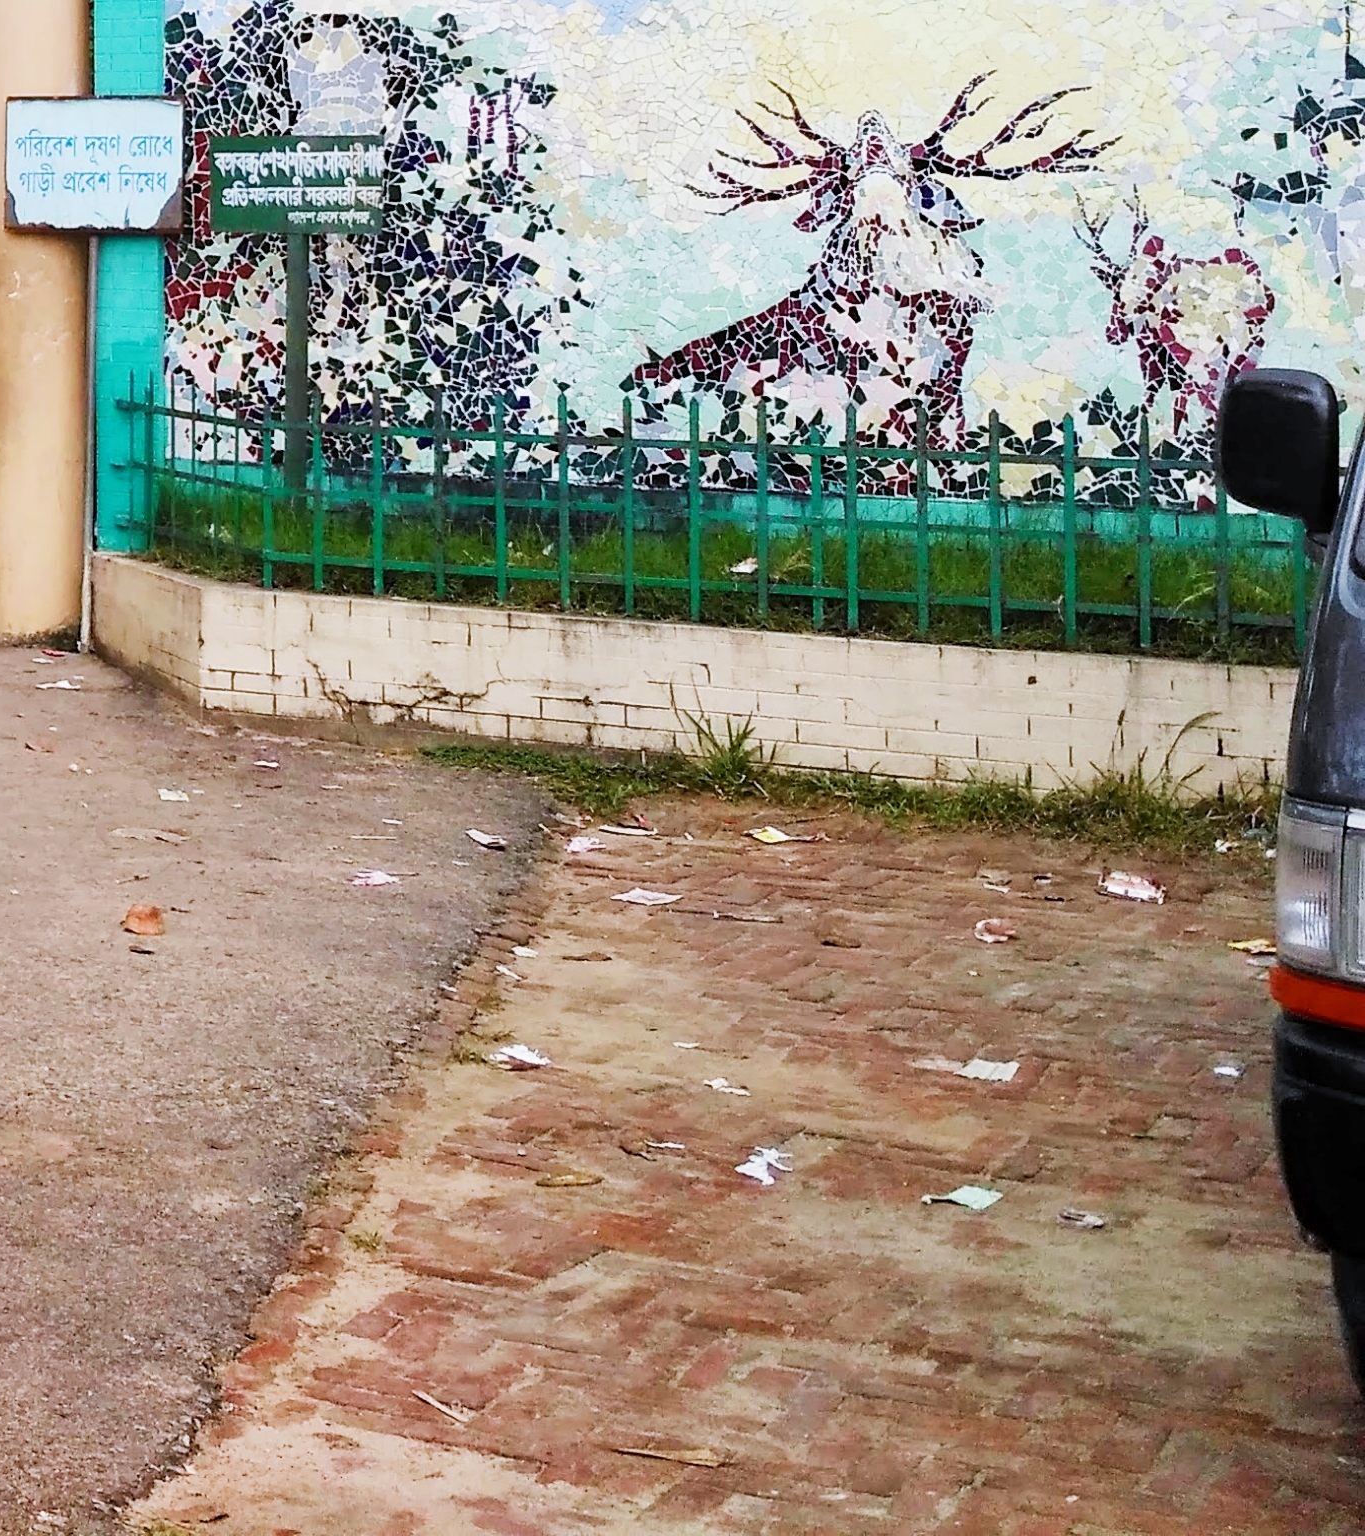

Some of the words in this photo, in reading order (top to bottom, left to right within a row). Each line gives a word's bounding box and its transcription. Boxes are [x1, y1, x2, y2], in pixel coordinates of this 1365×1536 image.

[15, 128, 77, 157] পরিবেশ
[84, 134, 120, 165] দূষণ
[129, 135, 173, 157] রোধে
[19, 163, 55, 197] গাড়ী
[62, 170, 110, 193] প্রবেশ
[118, 164, 167, 193] নিষেধ
